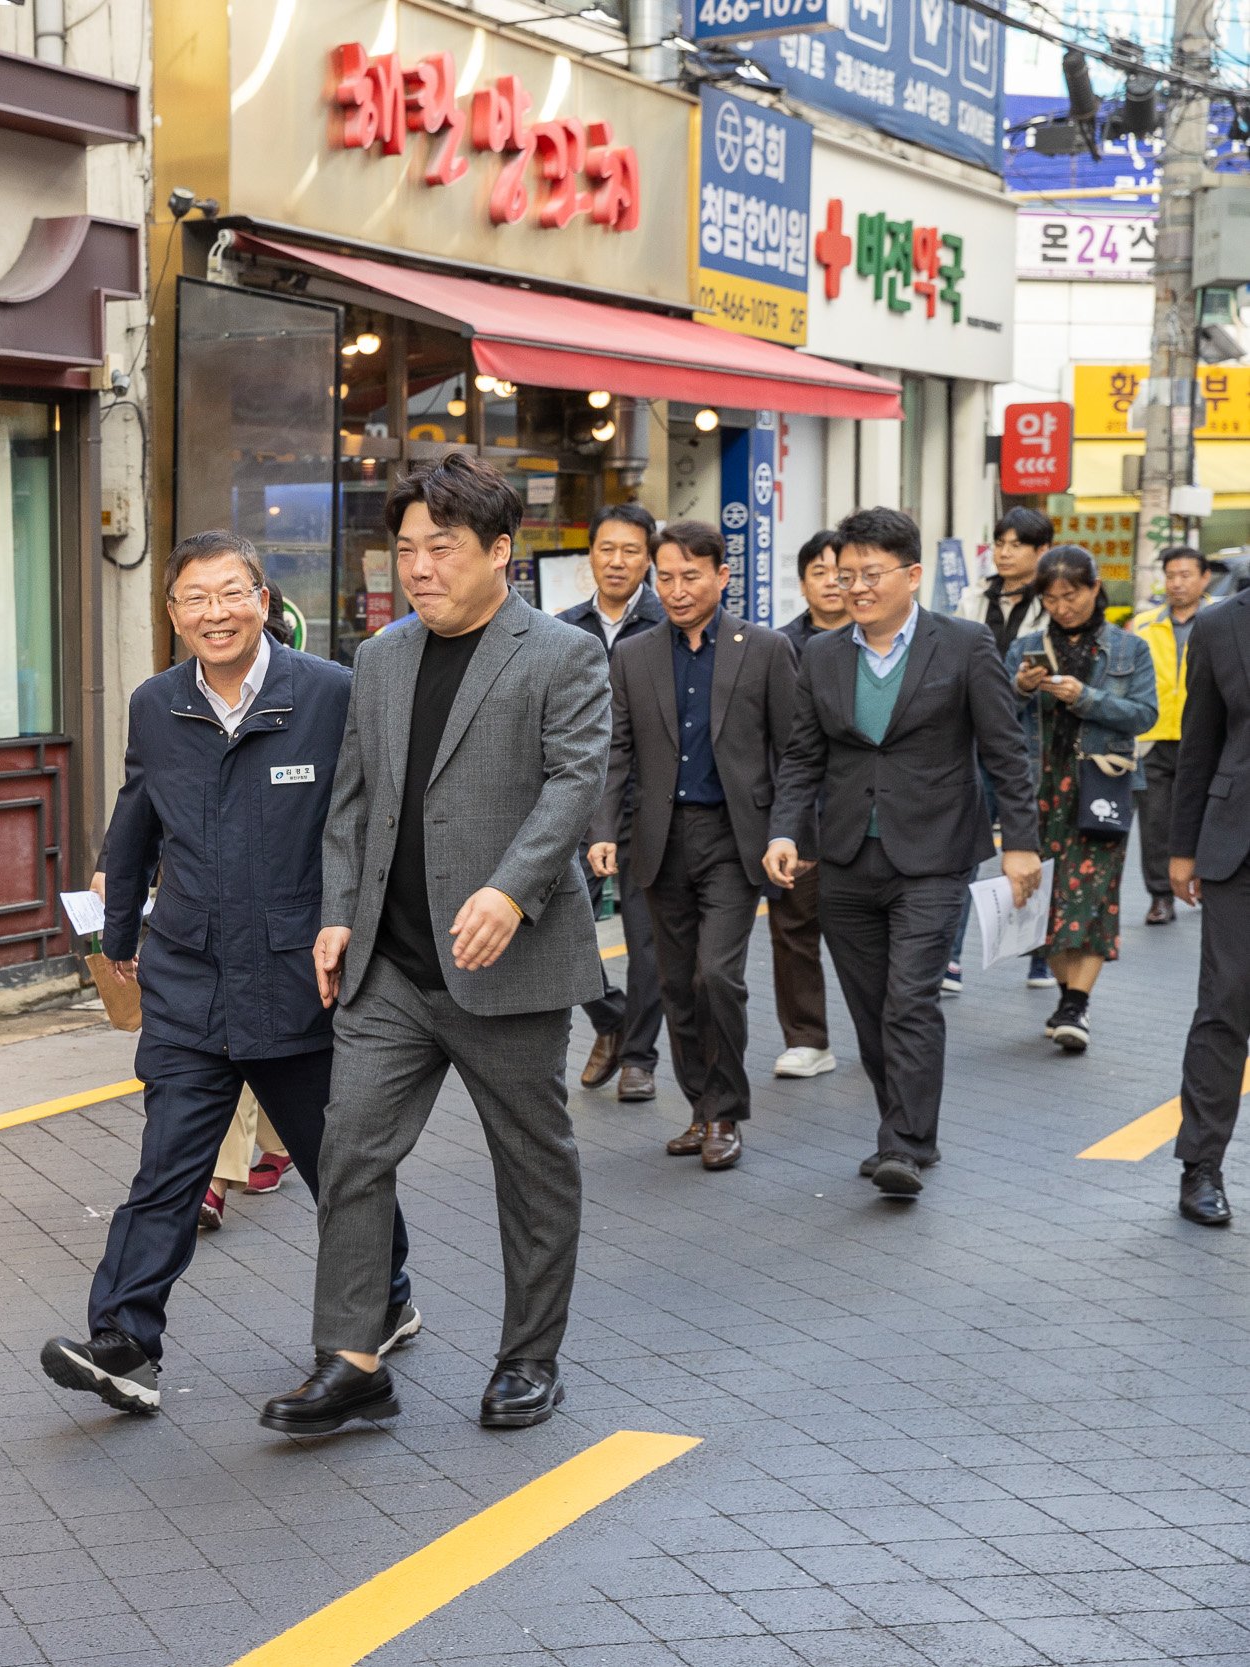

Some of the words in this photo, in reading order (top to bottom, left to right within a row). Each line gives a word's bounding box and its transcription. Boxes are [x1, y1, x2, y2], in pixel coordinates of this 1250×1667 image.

[744, 115, 786, 184] 경희
[701, 182, 808, 278] 청담한의원
[857, 212, 966, 324] 비전약국
[700, 286, 780, 331] 02-466-1075
[790, 306, 806, 334] 2F
[1017, 411, 1058, 454] 약
